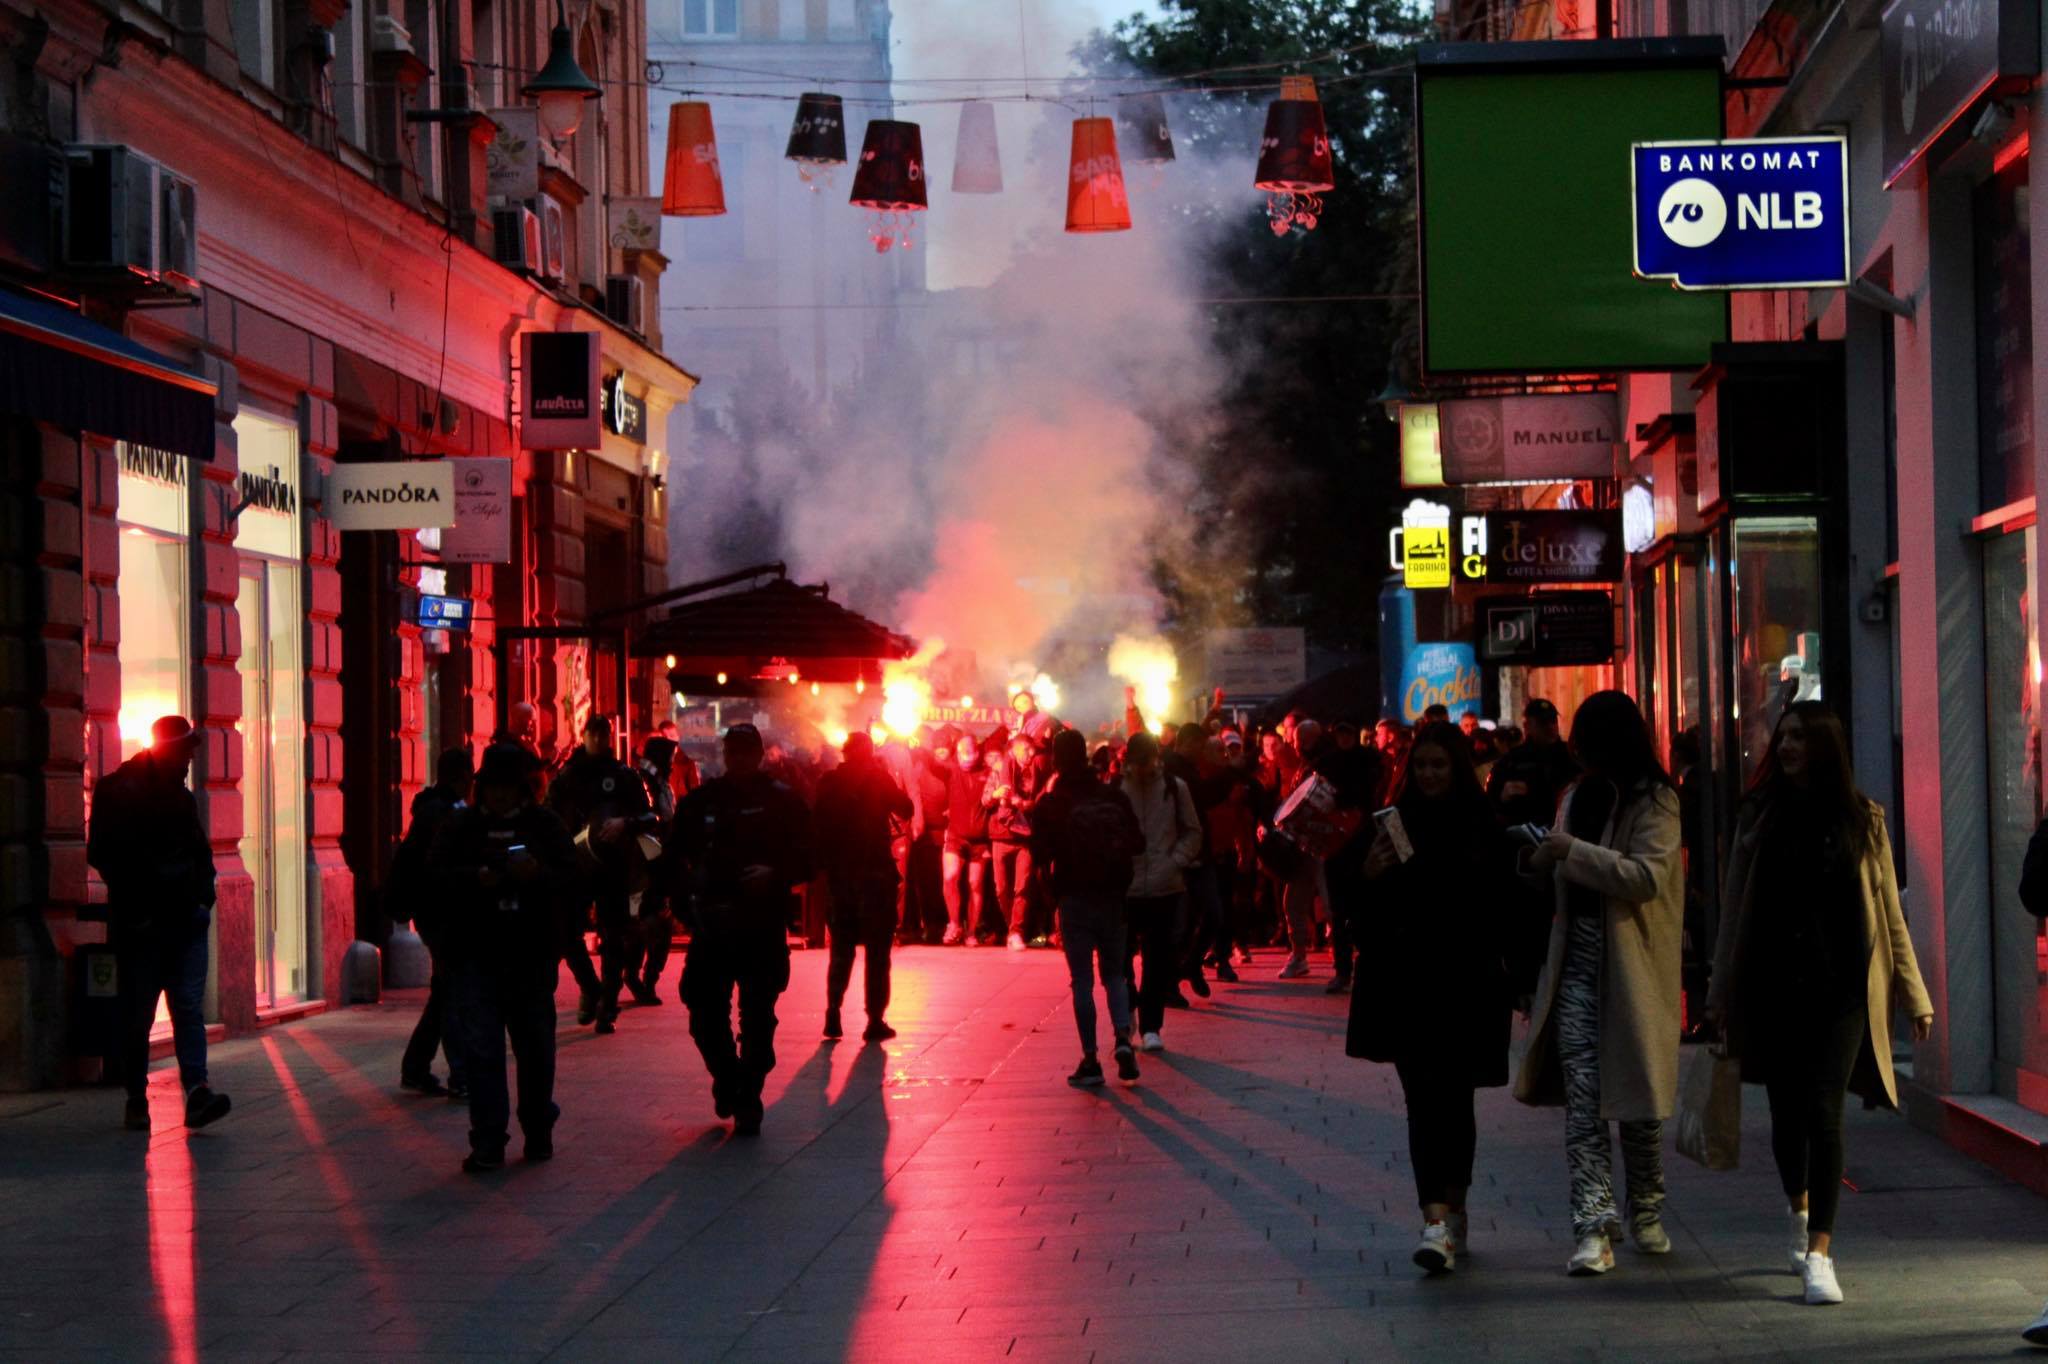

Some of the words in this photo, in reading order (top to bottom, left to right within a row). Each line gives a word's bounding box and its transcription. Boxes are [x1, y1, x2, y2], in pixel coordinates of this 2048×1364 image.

[1659, 151, 1820, 172] BANKOMAT
[1737, 191, 1824, 231] NLB
[535, 395, 585, 411] LAVAZZA
[1513, 428, 1611, 446] MANUEL
[342, 484, 440, 505] PANDORA
[1502, 520, 1604, 564] deluxe
[1407, 562, 1447, 574] FABRIKA
[1499, 621, 1525, 641] DI
